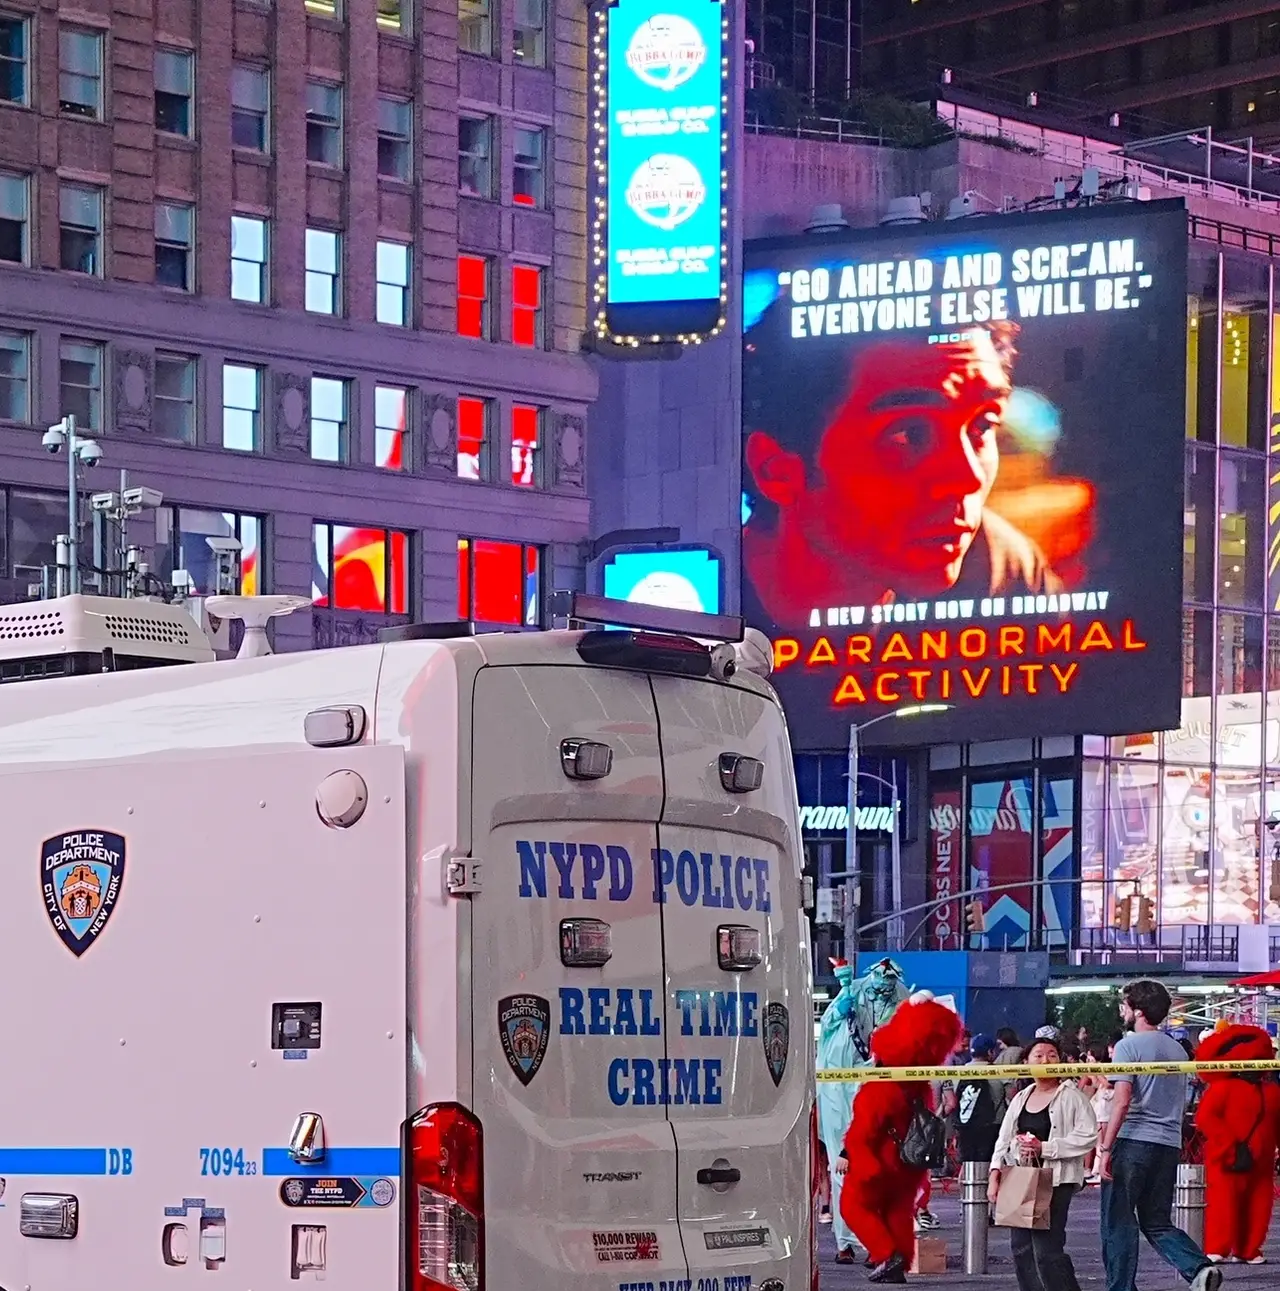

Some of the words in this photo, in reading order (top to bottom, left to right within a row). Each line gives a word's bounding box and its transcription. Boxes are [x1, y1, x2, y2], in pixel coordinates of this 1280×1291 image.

[838, 258, 933, 299] AHEAD
[942, 251, 1002, 290] AND
[790, 296, 931, 339] EVERYONE
[940, 287, 1009, 325] ELSE
[1016, 279, 1086, 318] WILL
[809, 608, 821, 628] A
[827, 605, 866, 626] NEW
[871, 601, 929, 624] STORY
[935, 598, 974, 620] NOW
[981, 597, 1005, 616] ON
[1012, 591, 1110, 616] BROADWAY
[774, 618, 1147, 668] PARANORMAL
[834, 662, 1079, 703] ACTIVITY
[798, 799, 902, 833] ramount
[45, 846, 120, 870] DEPARTMENT
[62, 834, 104, 849] POLICE
[516, 840, 634, 901] NYPD
[650, 848, 772, 913] POLICE
[44, 883, 58, 912] CITY
[89, 908, 108, 936] NEW
[104, 875, 120, 905] YORK
[936, 877, 952, 921] CBS
[502, 1006, 547, 1022] DEPARTMENT
[512, 997, 538, 1007] POLICE
[558, 987, 661, 1036] REAL
[675, 990, 758, 1037] TIME
[502, 1031, 511, 1053] CITY
[532, 1051, 542, 1071] NEW
[540, 1029, 548, 1049] YORK
[607, 1057, 722, 1106] CRIME
[109, 1148, 132, 1176] DB
[583, 1171, 642, 1182] TRANSIT
[315, 1179, 338, 1188] JOIN
[593, 1232, 624, 1246] $10,000
[625, 1232, 657, 1244] REWARD
